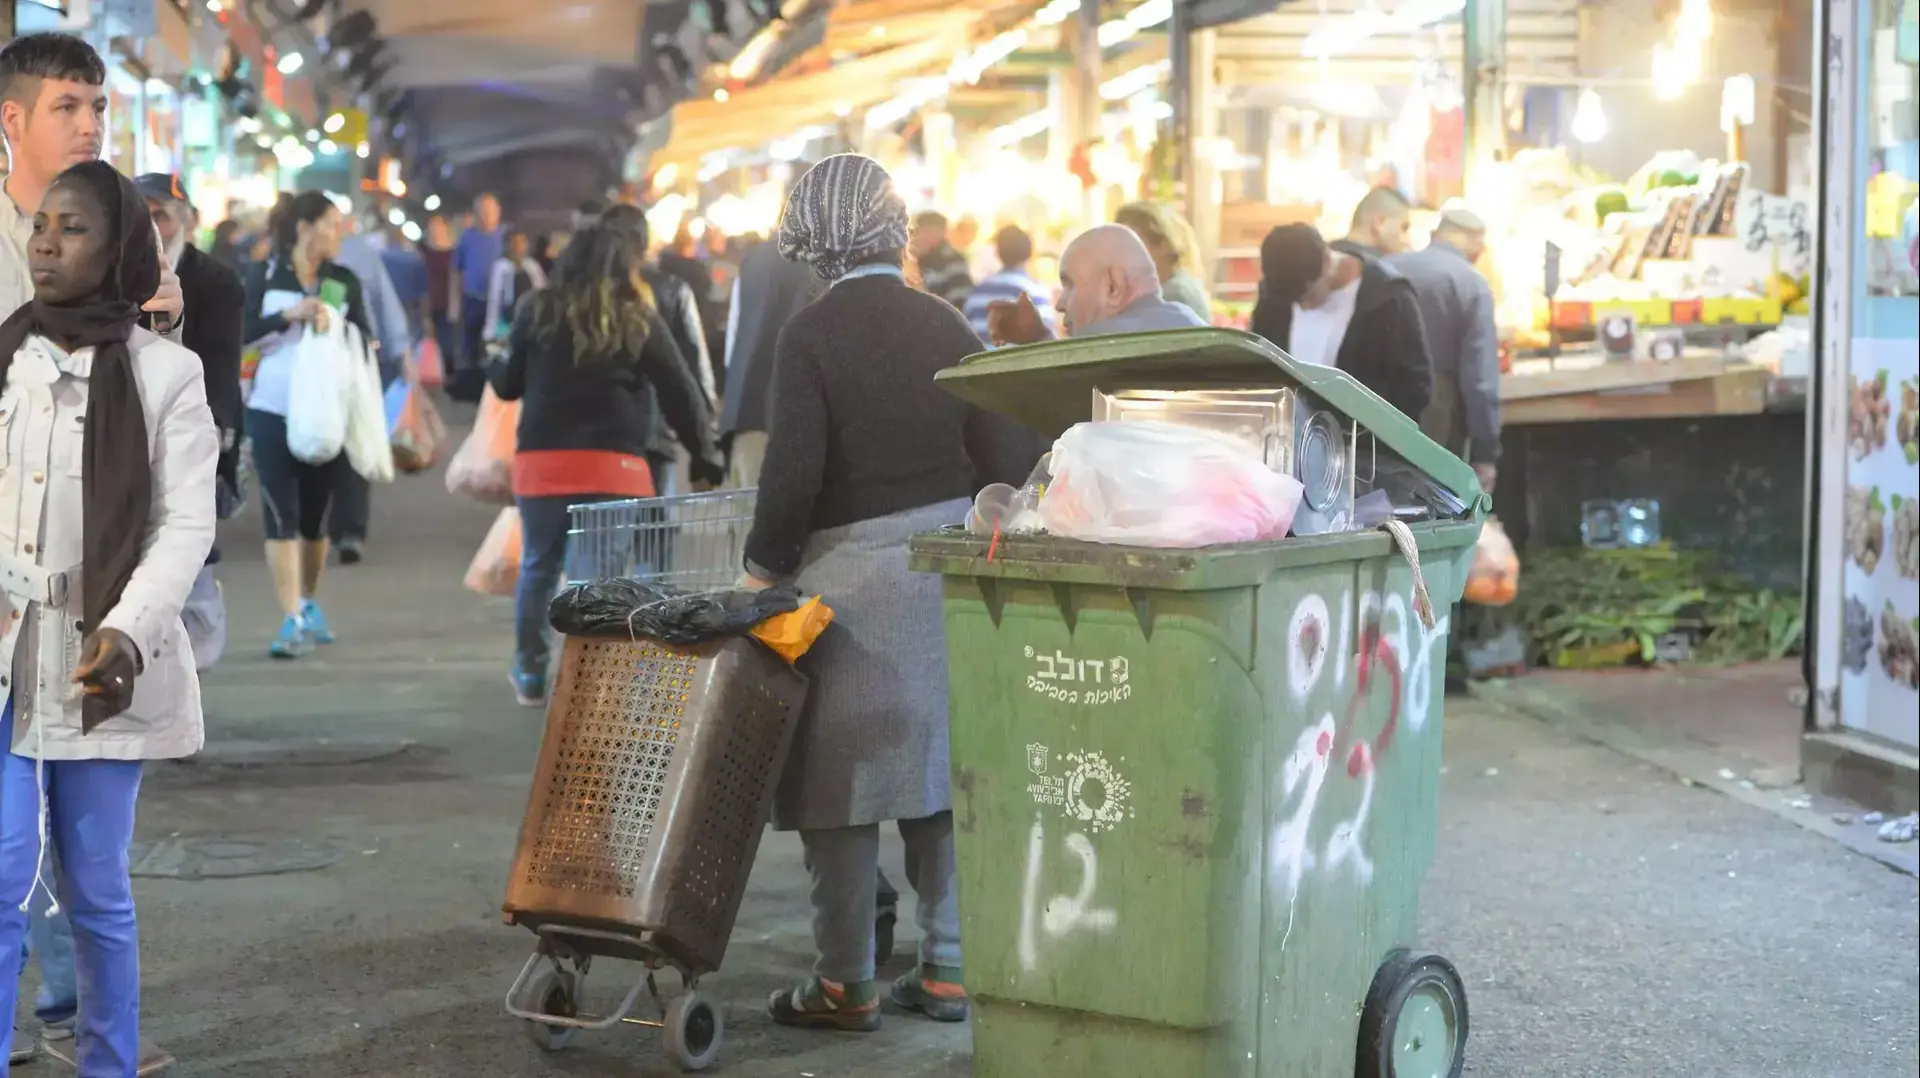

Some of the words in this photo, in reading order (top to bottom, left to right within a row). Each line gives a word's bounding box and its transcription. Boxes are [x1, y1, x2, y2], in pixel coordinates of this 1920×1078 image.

[1037, 650, 1104, 683] דולב
[1039, 775, 1053, 786] TEL
[1026, 784, 1045, 794] AVIV
